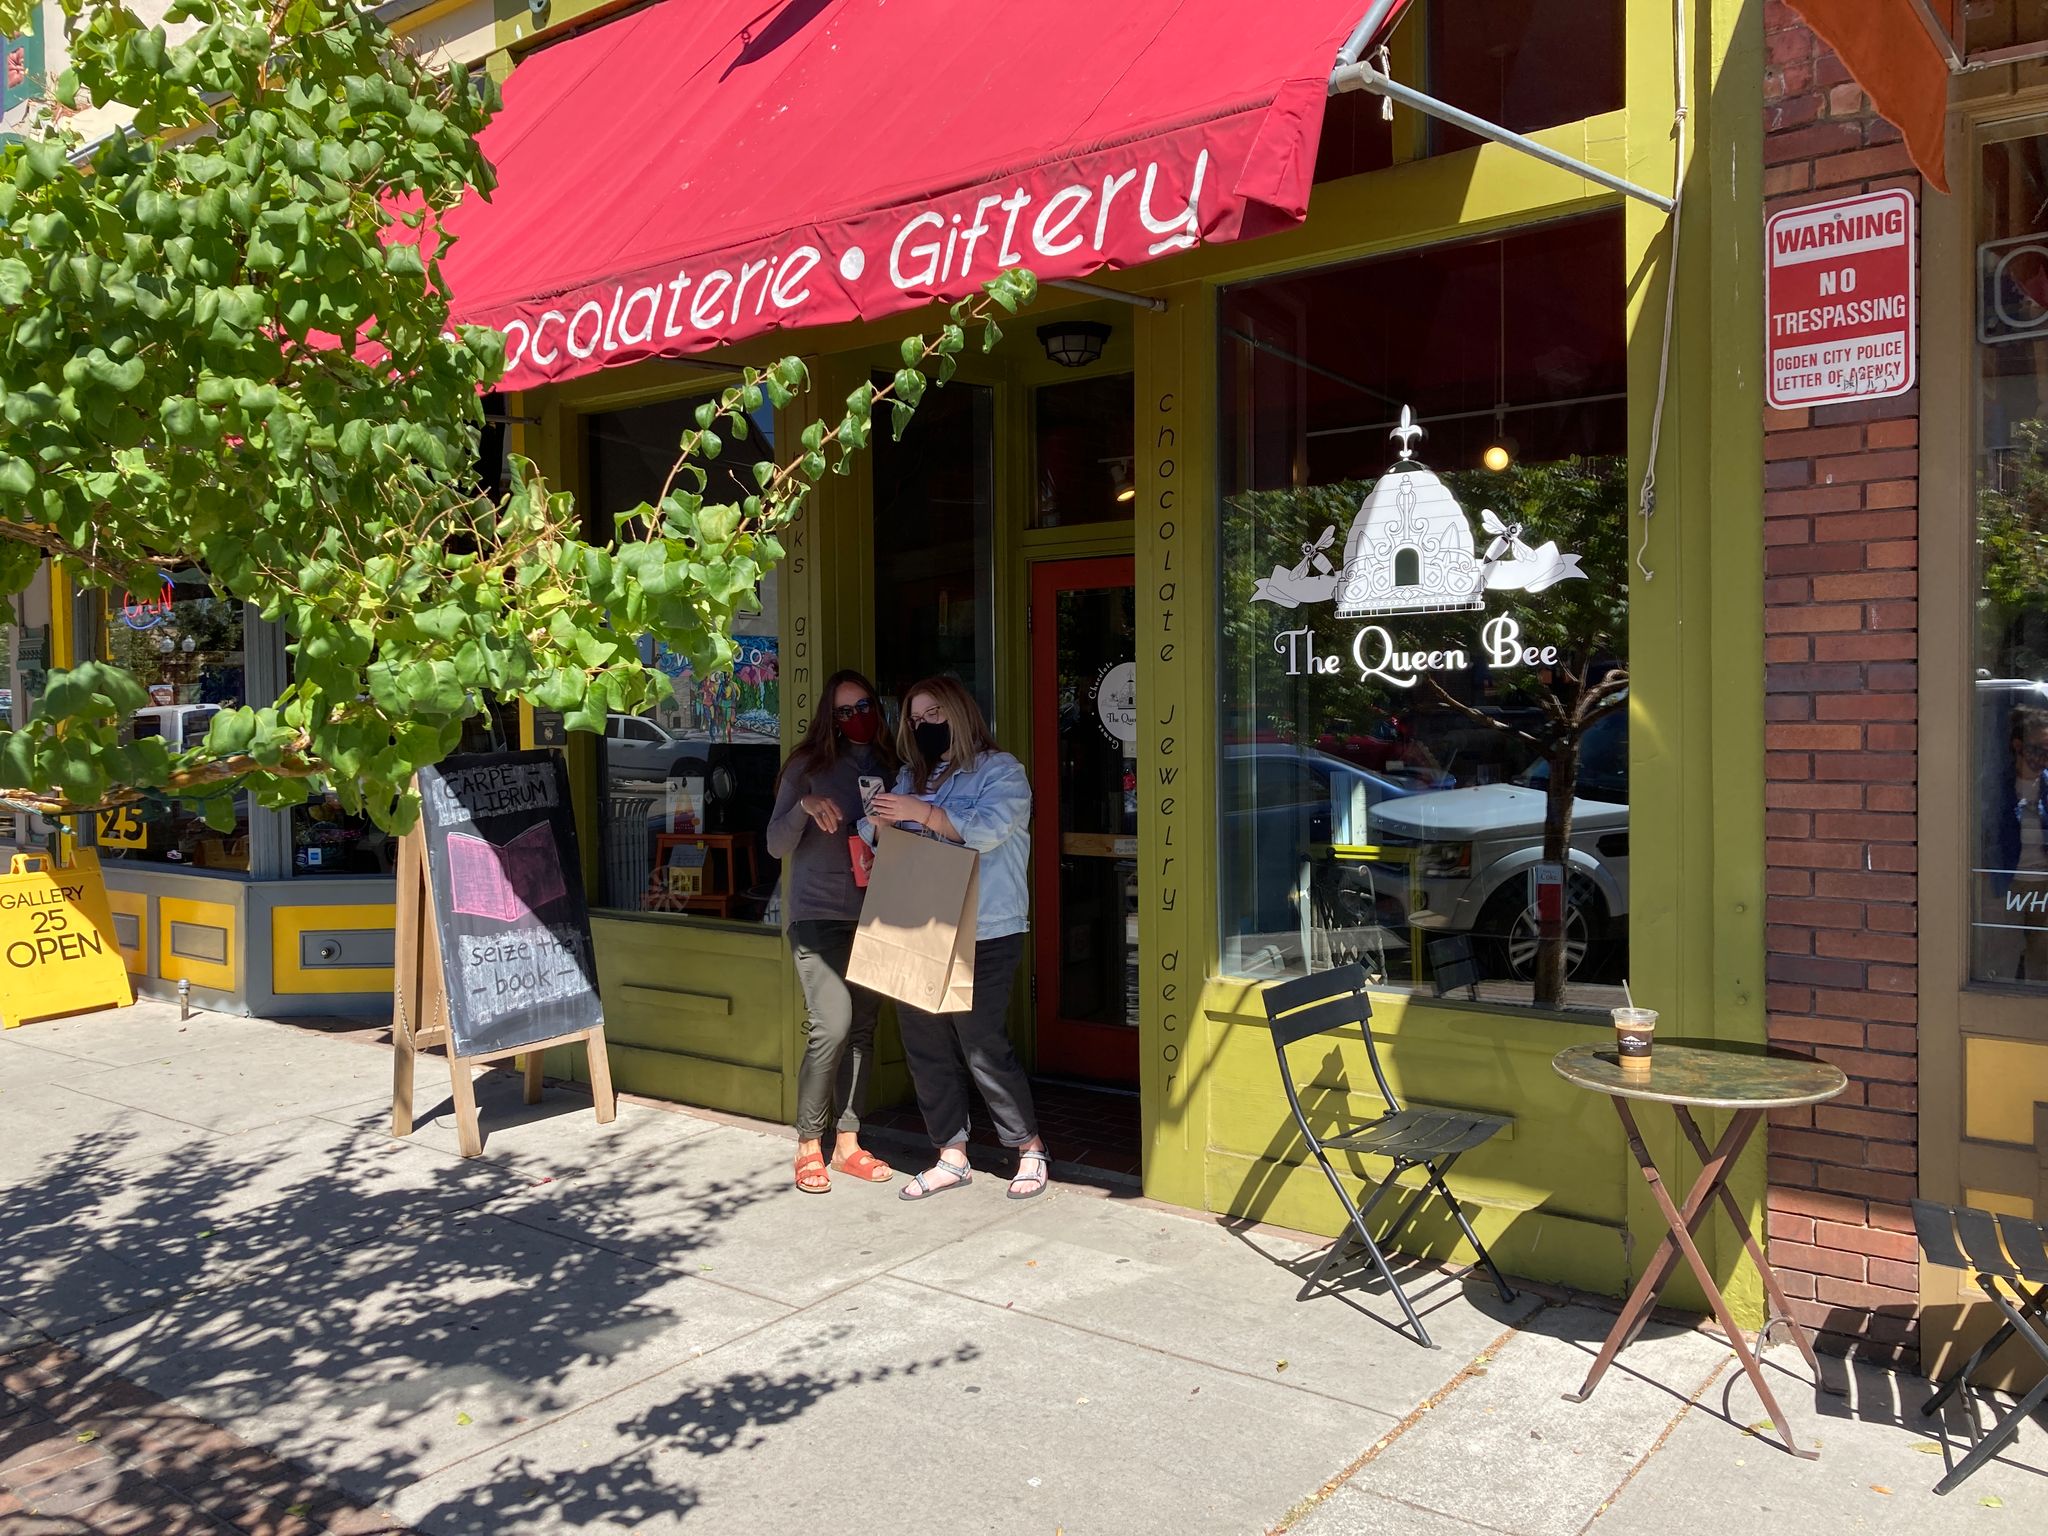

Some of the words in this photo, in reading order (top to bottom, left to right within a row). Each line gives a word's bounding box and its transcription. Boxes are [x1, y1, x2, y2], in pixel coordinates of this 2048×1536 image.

[1776, 209, 1902, 254] WARNING
[440, 245, 821, 373] ocolaterie
[889, 149, 1209, 289] Giftery
[1819, 267, 1856, 297] NO
[1773, 294, 1906, 336] TRESPASSING
[1776, 353, 1818, 371] OGDEN
[1823, 348, 1851, 365] CITY
[1857, 340, 1902, 360] POLICE
[1777, 372, 1822, 391] LETTER
[1828, 369, 1844, 384] OF
[1849, 361, 1902, 382] AGENCY
[1158, 393, 1176, 662] chocolate
[1273, 624, 1341, 676] The
[1352, 625, 1468, 688] Queen
[1481, 610, 1559, 669] Bee
[793, 616, 809, 734] games
[444, 767, 518, 799] CARPE
[472, 780, 548, 812] LIBRUM
[100, 805, 146, 842] 25
[0, 885, 84, 909] GALLERY
[31, 908, 68, 934] 25
[6, 929, 102, 968] OPEN
[470, 940, 532, 967] seize
[536, 936, 577, 957] the
[494, 963, 553, 995] book
[1160, 949, 1179, 1092] decor
